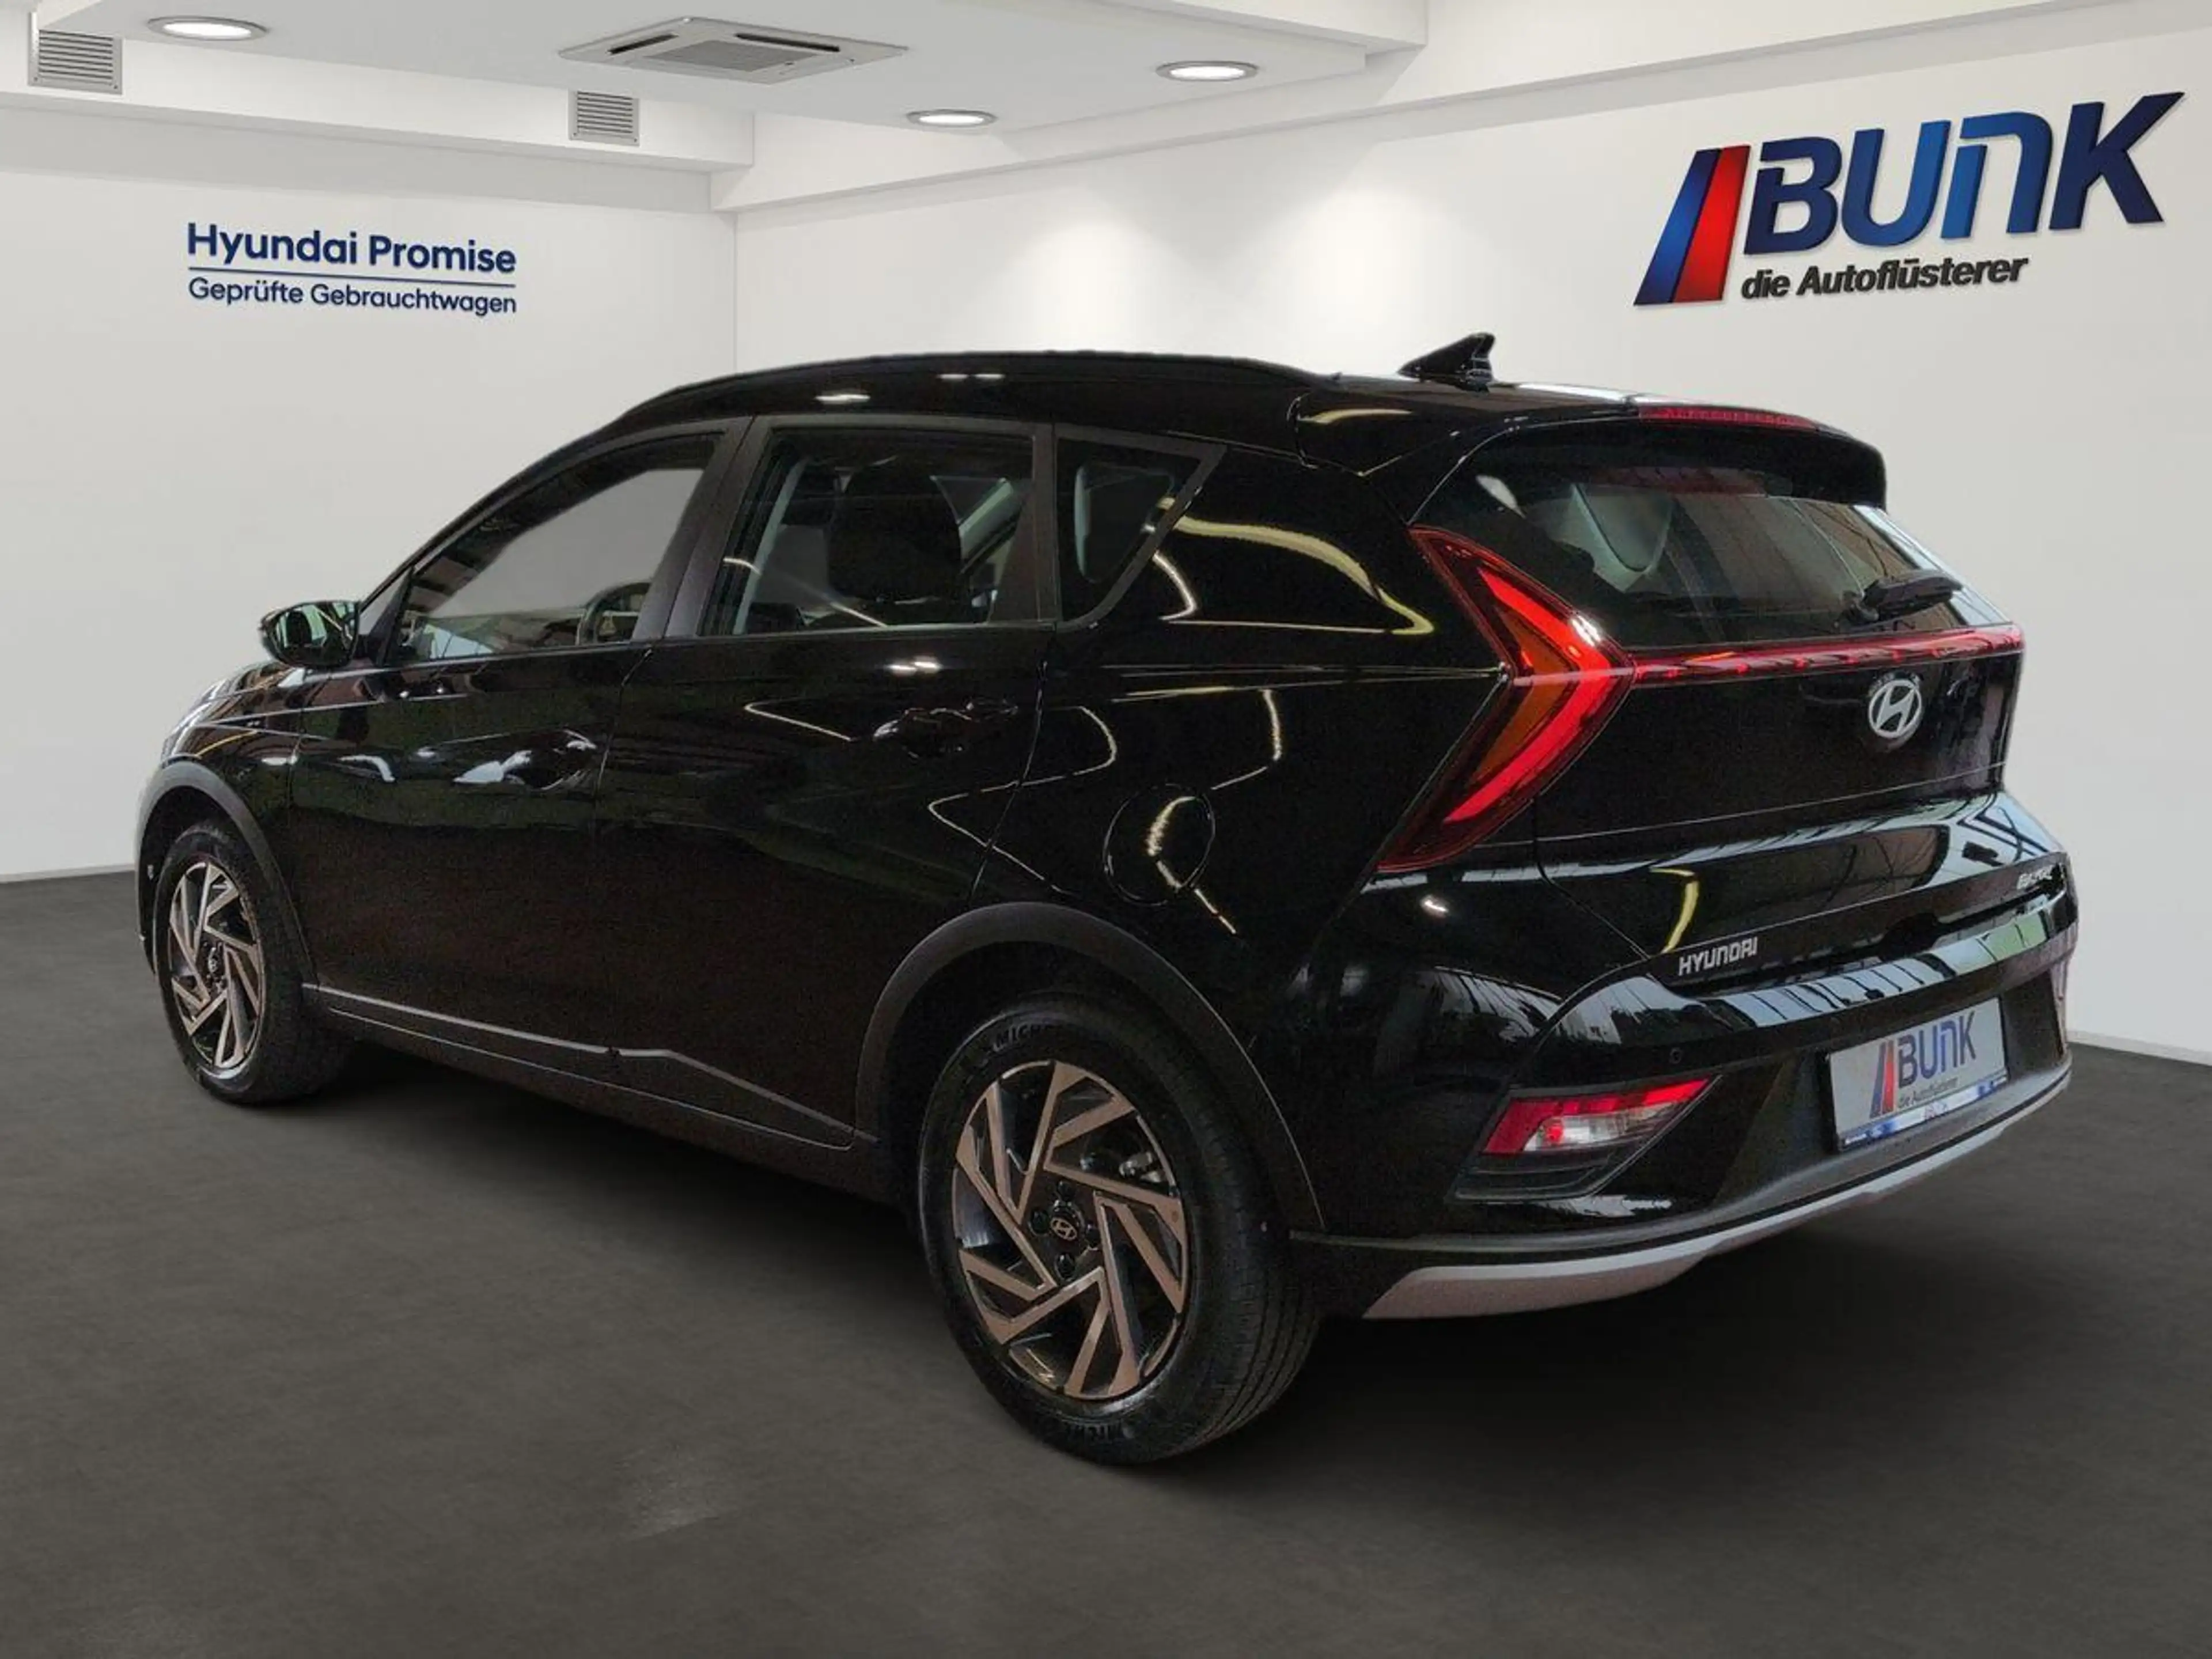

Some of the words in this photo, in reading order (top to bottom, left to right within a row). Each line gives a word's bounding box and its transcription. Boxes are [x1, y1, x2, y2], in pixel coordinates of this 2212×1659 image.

[1743, 91, 2186, 257] BUNK
[188, 222, 357, 265] Hyundai
[369, 235, 516, 274] Promise
[188, 276, 304, 305] Geprüfte
[310, 283, 517, 317] Gebrauchtwagen
[1741, 269, 1791, 300] die
[1796, 257, 2029, 296] Autoflüsterer
[1679, 937, 1758, 976] HYUNDAI
[1897, 1010, 1976, 1089] BUNK
